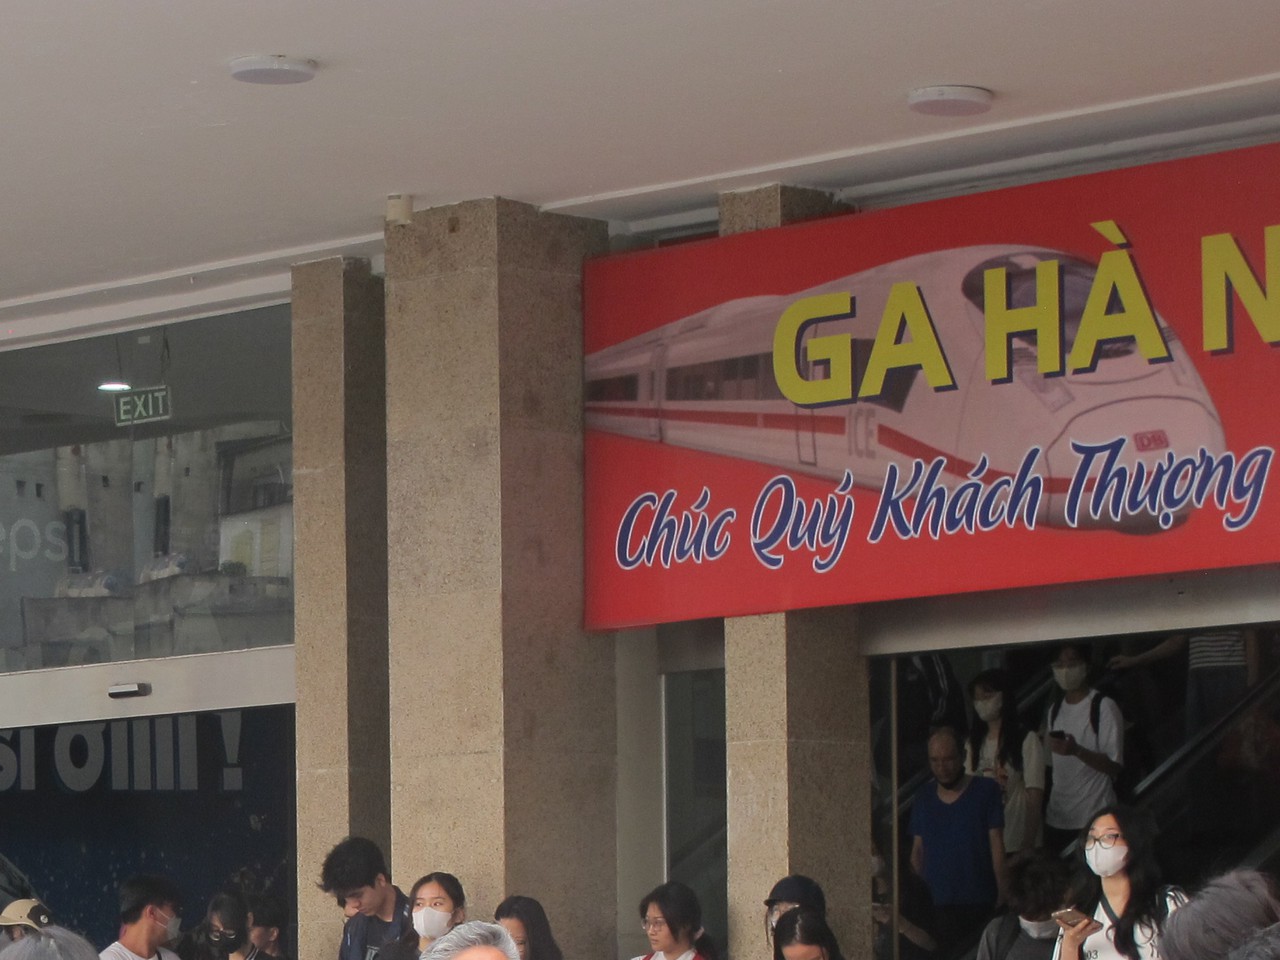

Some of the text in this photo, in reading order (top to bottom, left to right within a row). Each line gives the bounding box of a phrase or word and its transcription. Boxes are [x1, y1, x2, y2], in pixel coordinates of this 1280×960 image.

[773, 281, 956, 406] GA
[984, 220, 1172, 382] HÀ
[120, 391, 166, 420] EXIT
[615, 435, 1274, 573] Chúc Quý Khách Thượng
